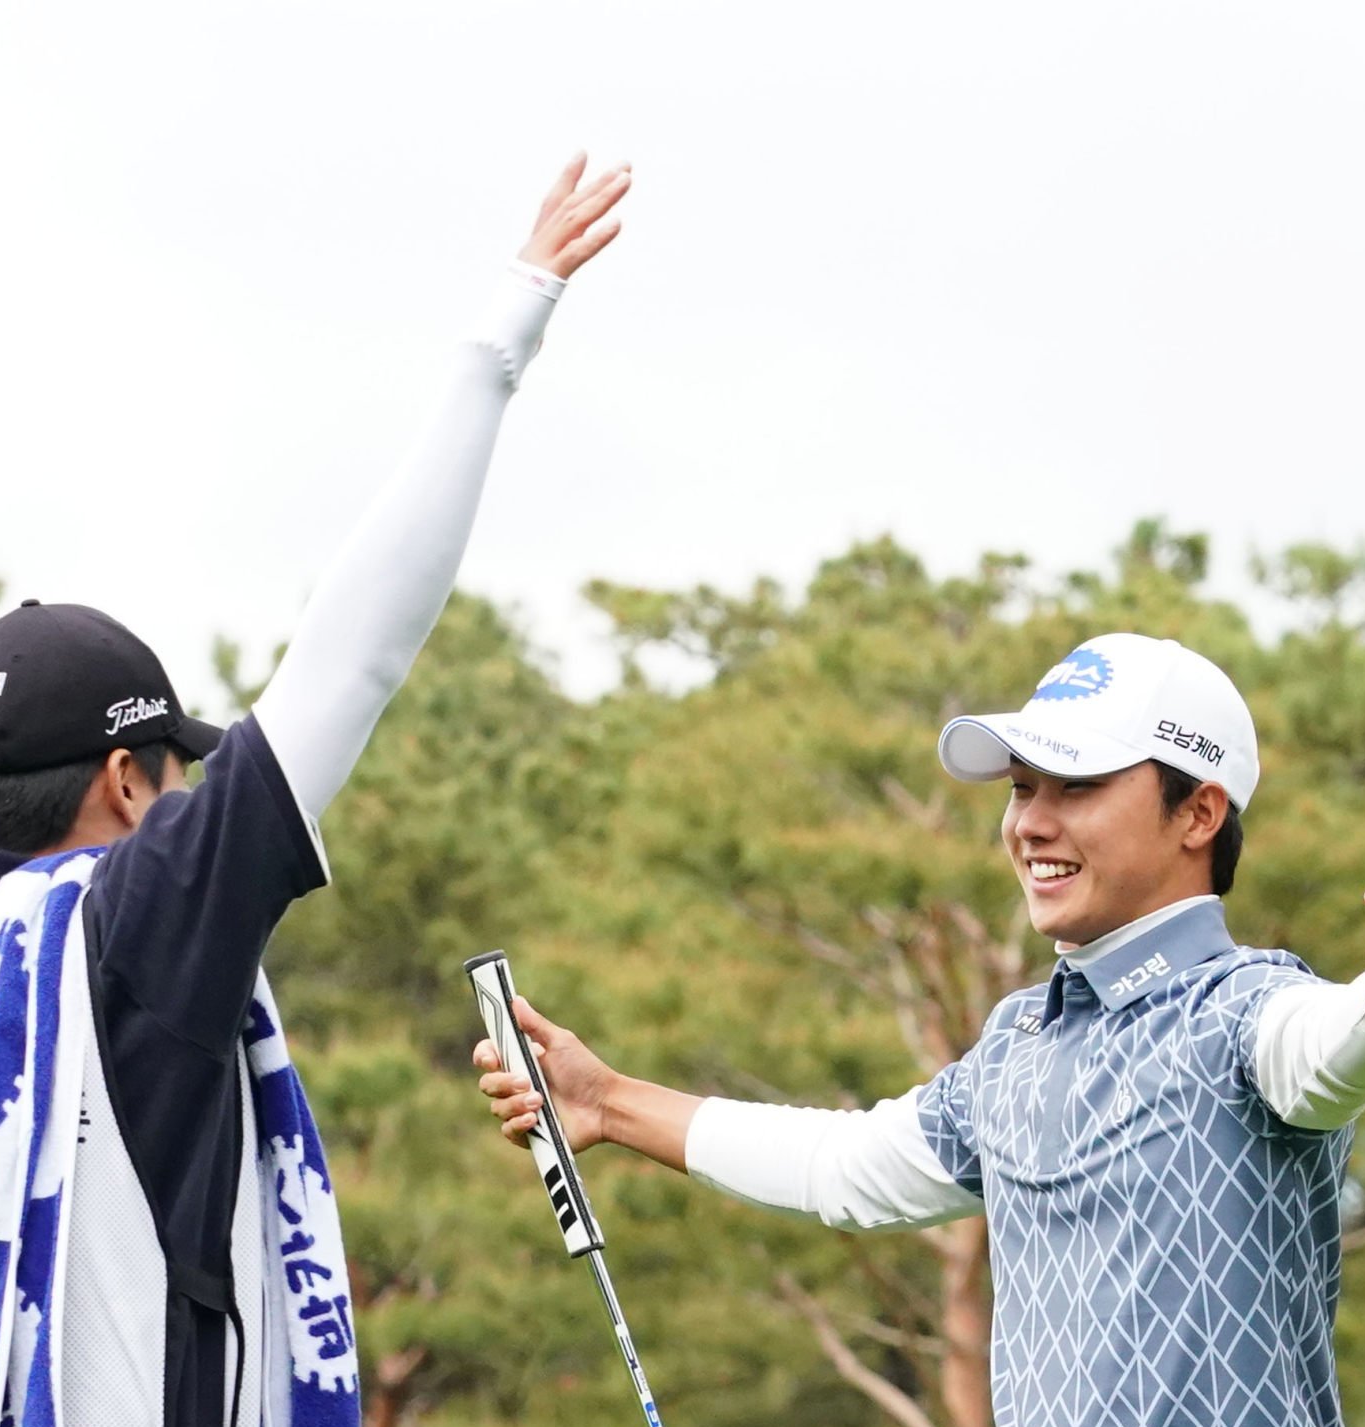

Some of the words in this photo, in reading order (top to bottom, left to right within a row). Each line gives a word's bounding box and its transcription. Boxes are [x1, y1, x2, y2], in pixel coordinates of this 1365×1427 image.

[105, 697, 168, 735] Titleist
[1153, 719, 1226, 767] 모닝케어
[1109, 952, 1172, 997] 가그린
